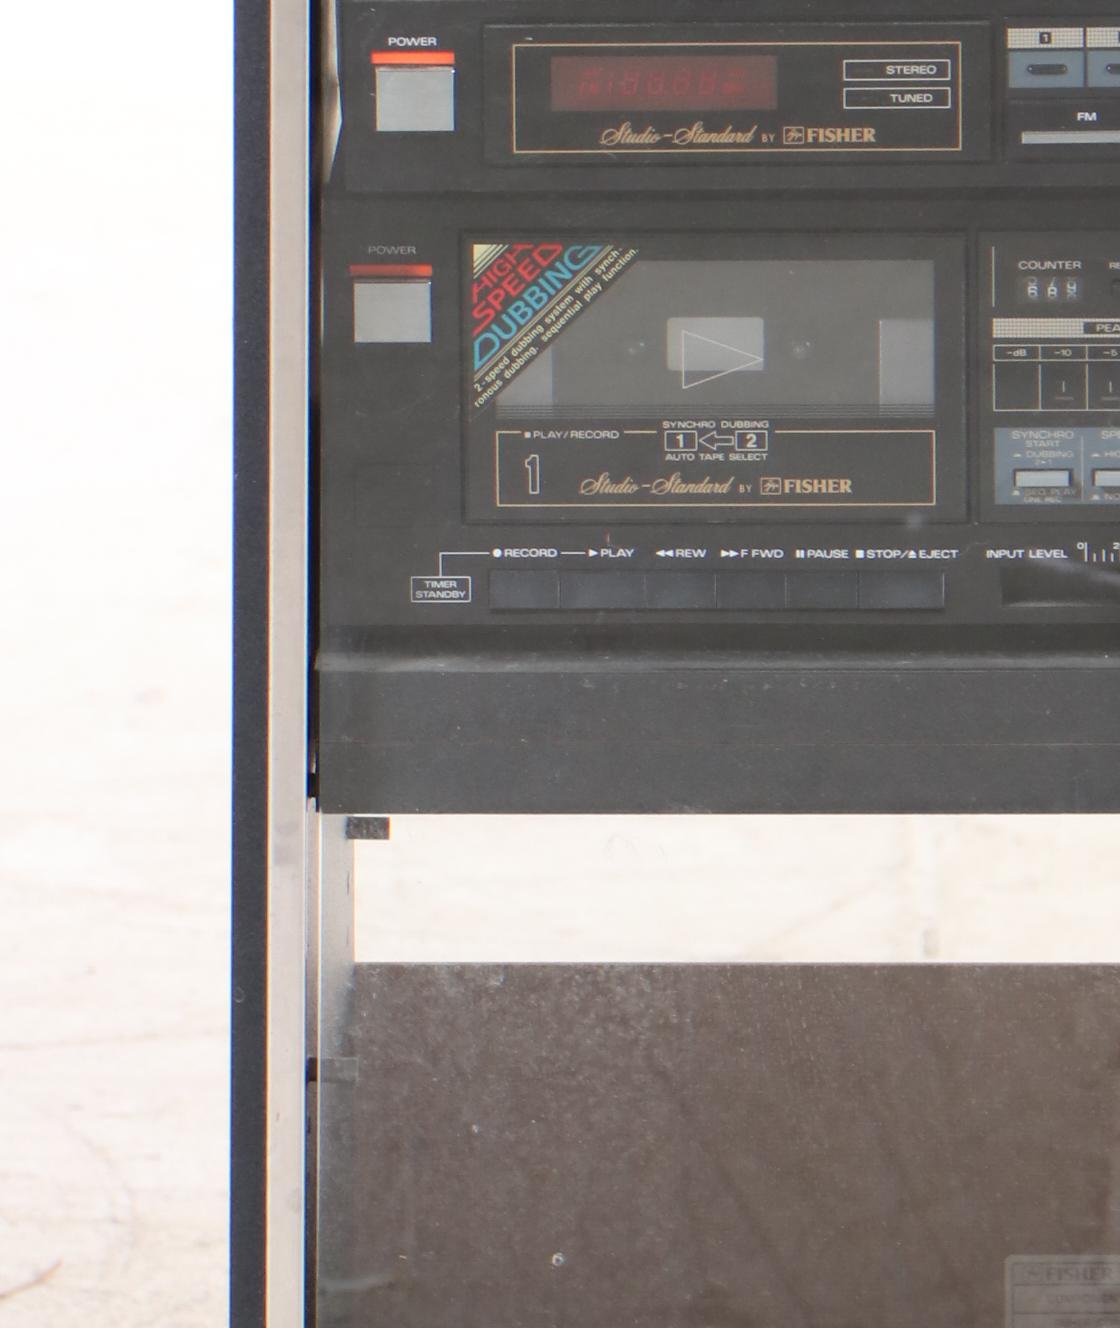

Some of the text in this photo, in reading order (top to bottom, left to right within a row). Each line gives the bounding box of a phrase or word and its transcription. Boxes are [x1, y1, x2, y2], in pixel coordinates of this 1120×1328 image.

[388, 37, 436, 46] POWER
[1042, 33, 1050, 42] 1
[886, 65, 936, 74] STEREO
[890, 94, 933, 103] TUNED
[1077, 112, 1096, 120] FM
[762, 134, 775, 142] BY
[807, 128, 875, 142] FISHER
[368, 246, 416, 254] POWER
[1018, 261, 1081, 270] COUNTER
[473, 243, 534, 304] HIGH
[472, 243, 563, 336] SPEED
[474, 245, 603, 370] DUBBING
[474, 247, 622, 392] 2-speed dubbing system with synch-
[474, 380, 503, 408] ronous
[542, 300, 583, 342] sequential
[584, 284, 602, 301] play
[663, 420, 769, 428] SYNCHRO DUBBING
[533, 430, 619, 439] PLAY/RECORD
[675, 434, 757, 448] 1 2
[665, 453, 767, 461] AUTO TAPE SELECT
[524, 454, 540, 495] 1
[739, 484, 752, 493] BY
[784, 479, 852, 493] FISHER
[504, 548, 557, 557] RECORD
[601, 549, 634, 557] PLAY
[675, 549, 707, 559] REW
[753, 549, 783, 559] FWD
[806, 549, 848, 559] PAUSE
[919, 549, 958, 559] EJECT
[986, 549, 1067, 558] INPUT LEVEL
[415, 590, 466, 599] STANDBY
